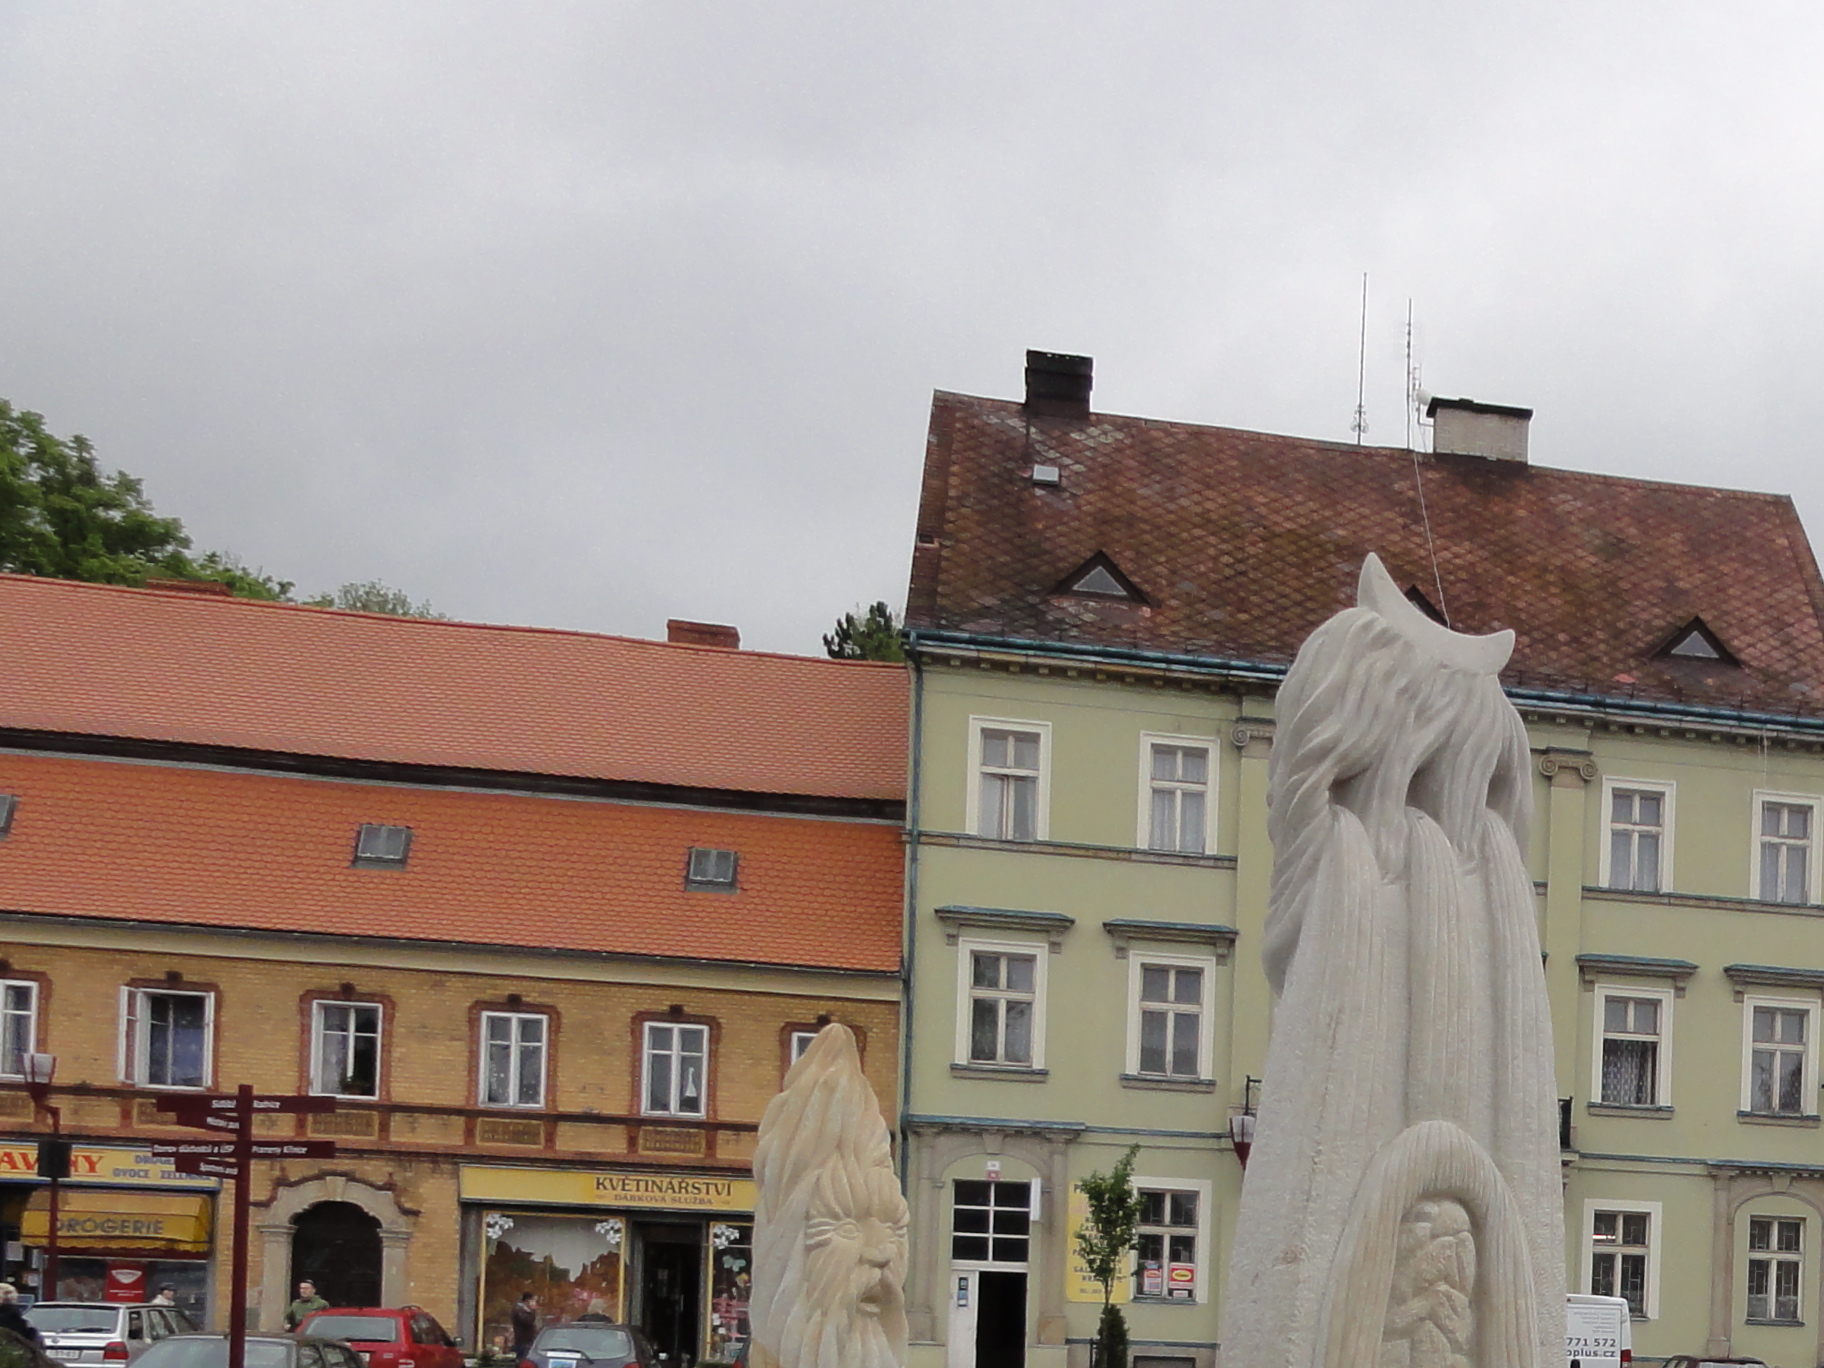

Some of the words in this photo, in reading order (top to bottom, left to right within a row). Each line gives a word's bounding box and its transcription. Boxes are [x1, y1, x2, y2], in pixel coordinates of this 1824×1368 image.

[113, 1168, 150, 1178] OVOCE
[595, 1176, 732, 1197] KVĚTINÁŘSTVÍ
[671, 1196, 714, 1205] SLUŽBA
[1567, 1337, 1589, 1347] 771
[1593, 1338, 1616, 1348] 572
